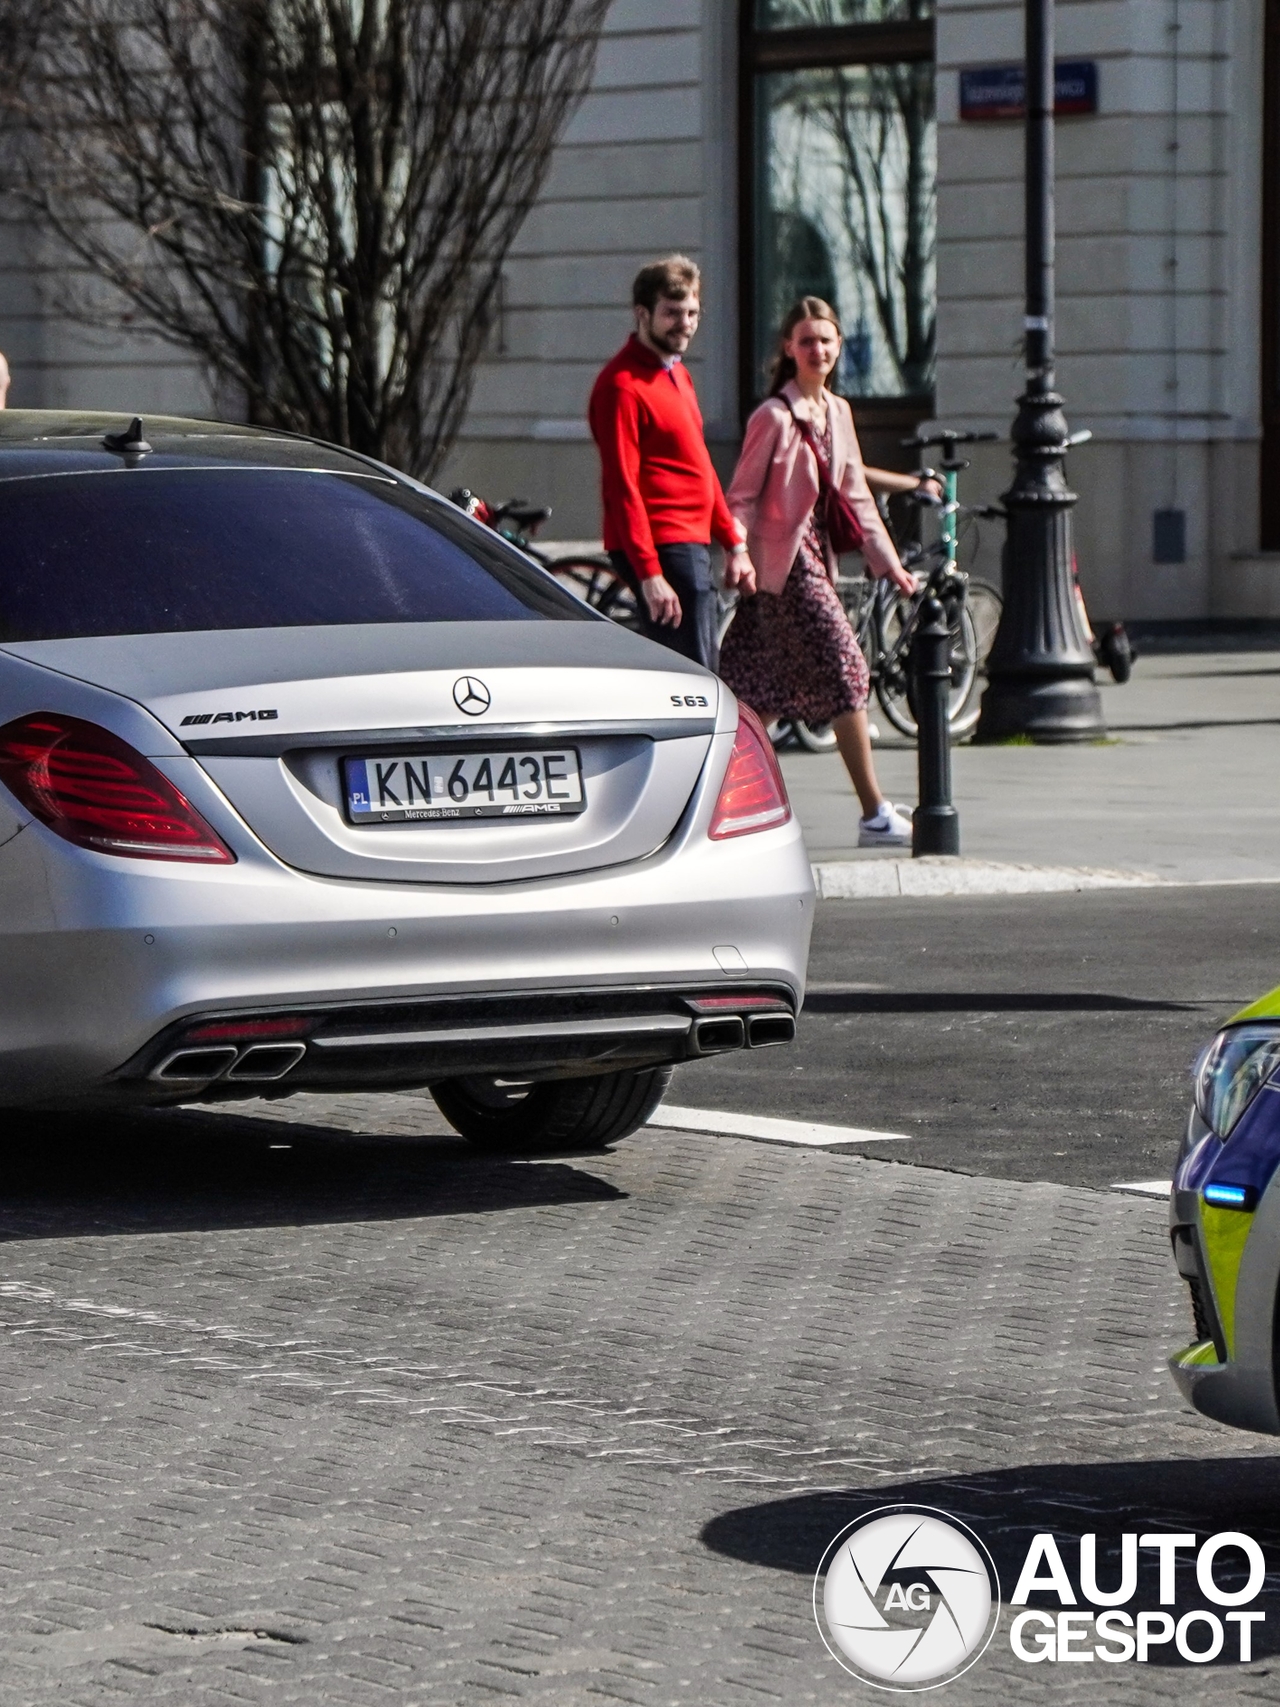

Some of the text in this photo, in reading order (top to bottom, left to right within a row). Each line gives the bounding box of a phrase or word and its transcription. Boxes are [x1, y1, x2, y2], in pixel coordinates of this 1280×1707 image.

[670, 695, 709, 707] S63
[211, 709, 279, 724] AMG
[375, 755, 570, 807] KN 6443E
[353, 792, 368, 805] PL
[404, 808, 460, 819] Mercedes-Benz
[521, 803, 561, 813] AMG
